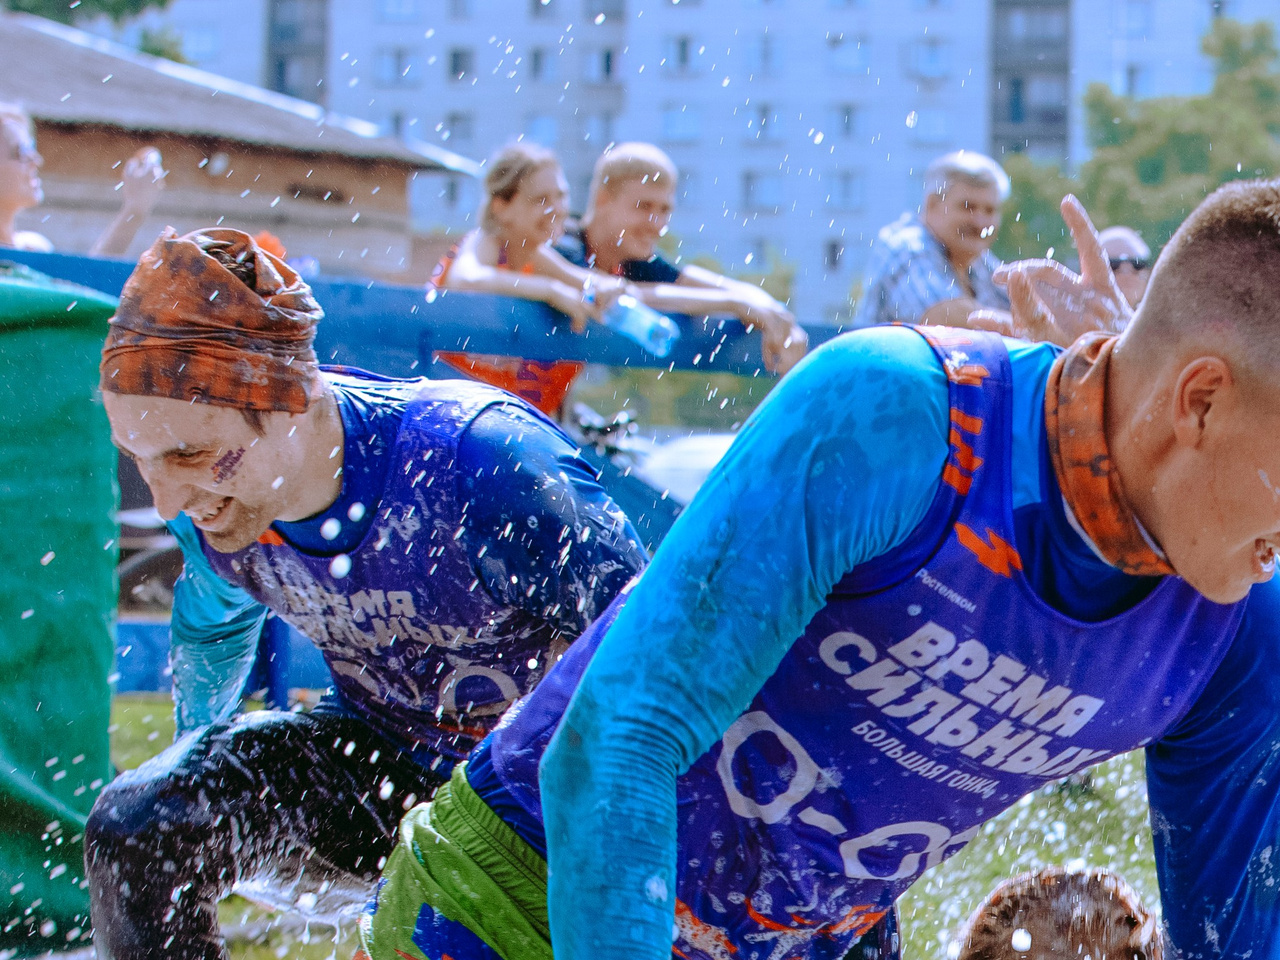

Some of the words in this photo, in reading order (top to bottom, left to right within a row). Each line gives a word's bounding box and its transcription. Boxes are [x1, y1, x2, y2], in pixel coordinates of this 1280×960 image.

[818, 630, 1110, 777] СИЛЬНЫХ
[887, 620, 1106, 738] ВРЕМЯ
[717, 709, 981, 882] 0-0
[850, 719, 950, 780] БОЛЬШАЯ
[935, 769, 1001, 796] ГОНКА
